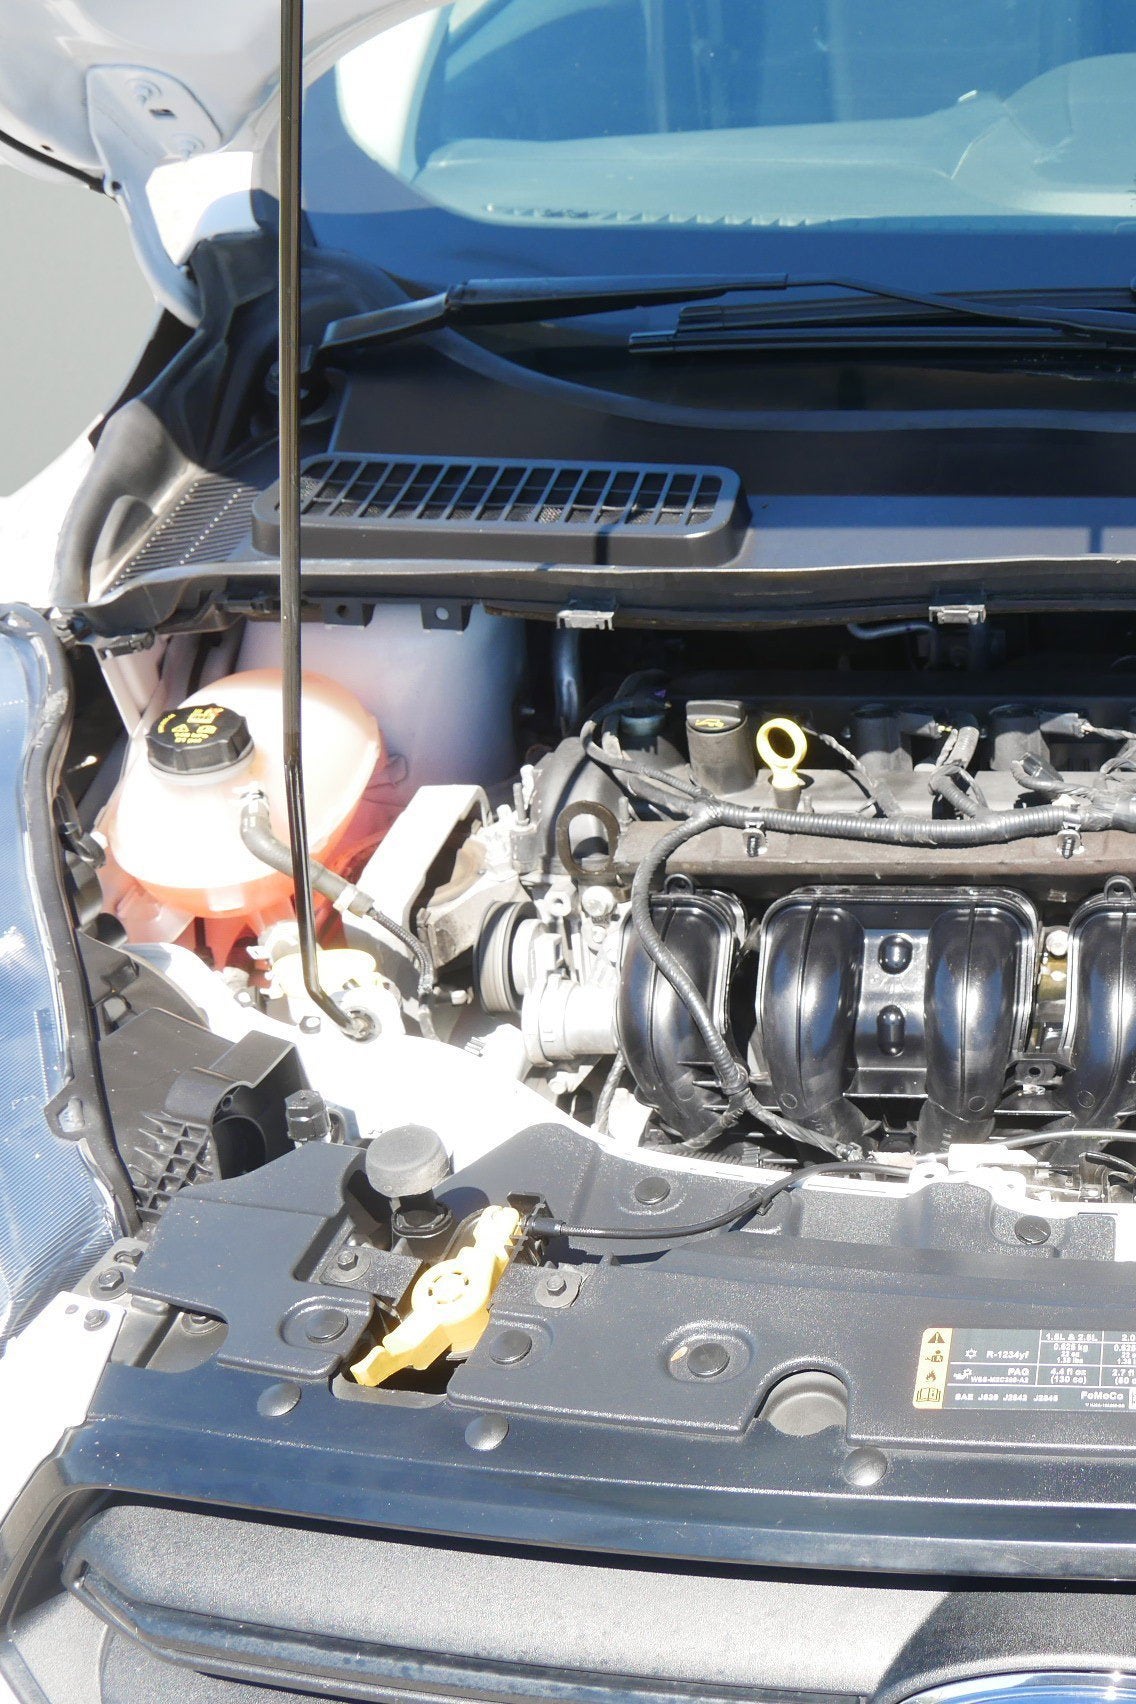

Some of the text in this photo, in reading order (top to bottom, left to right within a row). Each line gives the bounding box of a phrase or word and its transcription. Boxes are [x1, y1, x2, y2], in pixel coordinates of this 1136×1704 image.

[1067, 1333, 1076, 1341] &
[1077, 1343, 1089, 1353] kg
[986, 1350, 1030, 1360] R-1234yf
[1007, 1367, 1030, 1376] PAG
[1050, 1367, 1087, 1376] 4.4 fl oz
[1111, 1368, 1127, 1377] 2.7
[1127, 1368, 1136, 1377] fl
[1050, 1375, 1071, 1385] (130
[954, 1393, 974, 1401] SAE
[1080, 1390, 1124, 1400] FoMoCo
